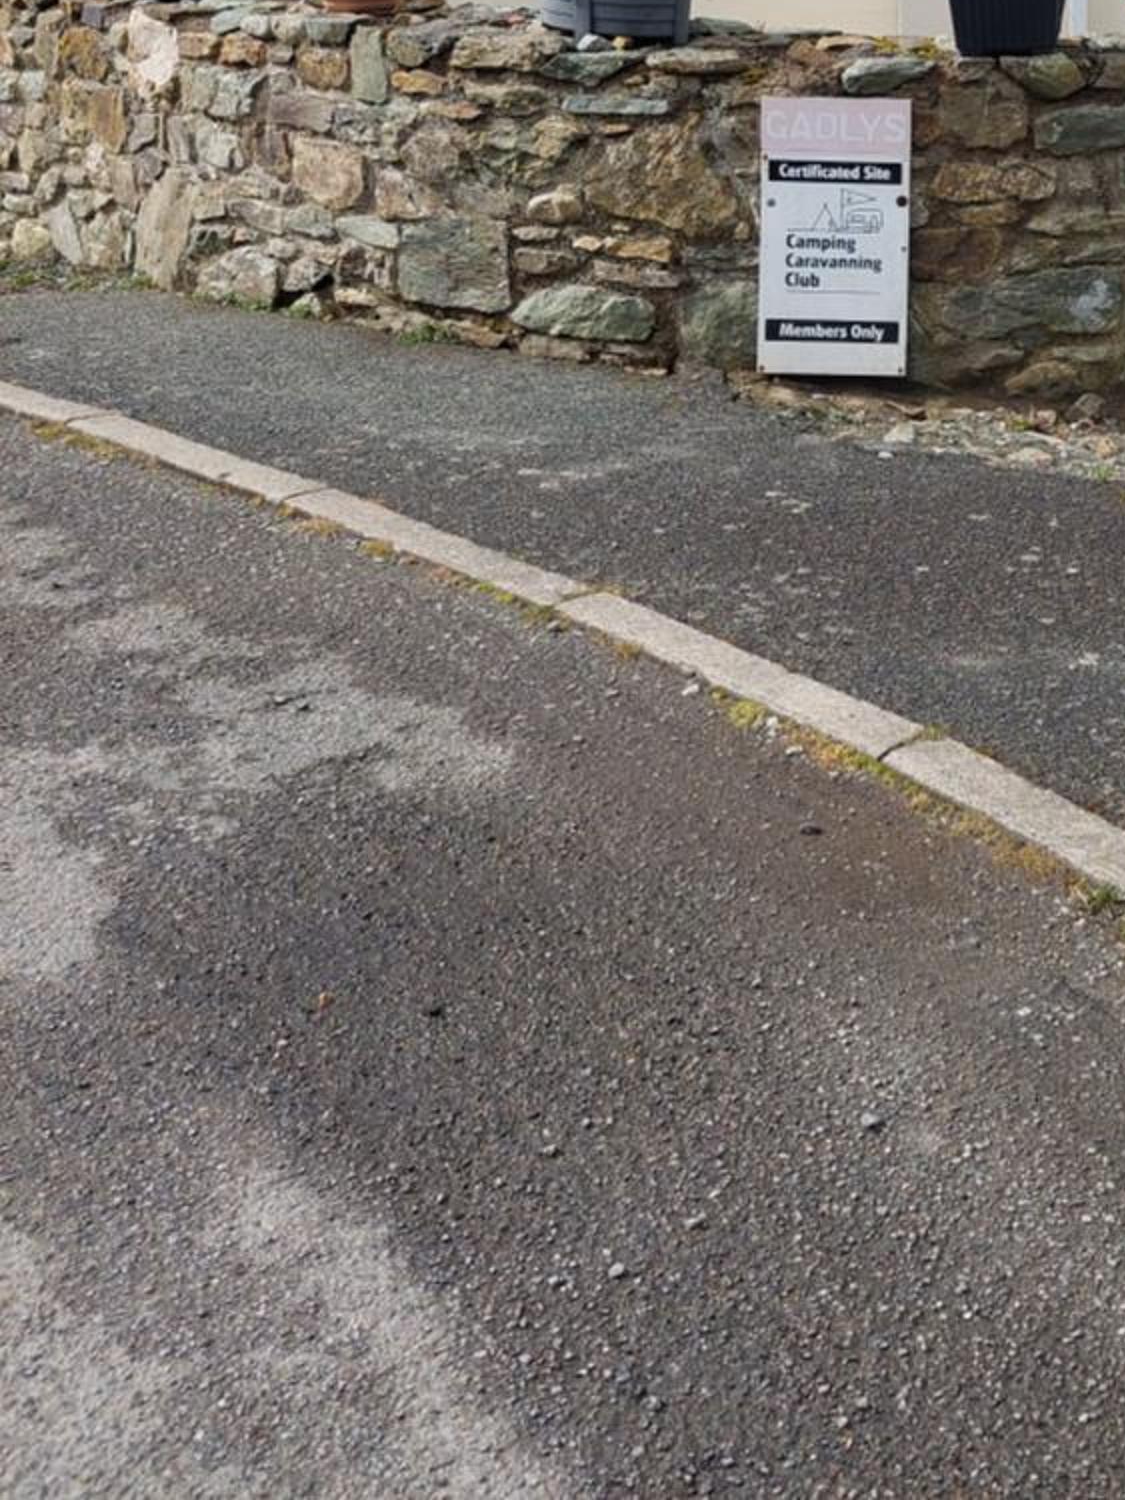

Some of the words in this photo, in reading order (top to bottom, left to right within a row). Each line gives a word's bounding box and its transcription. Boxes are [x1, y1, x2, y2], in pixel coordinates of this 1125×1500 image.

[779, 163, 860, 180] Certificated
[864, 164, 891, 181] Site
[785, 233, 856, 253] Camping
[785, 252, 882, 273] Caravanning
[785, 271, 820, 288] Club
[779, 322, 847, 339] Members
[851, 324, 884, 342] Only
